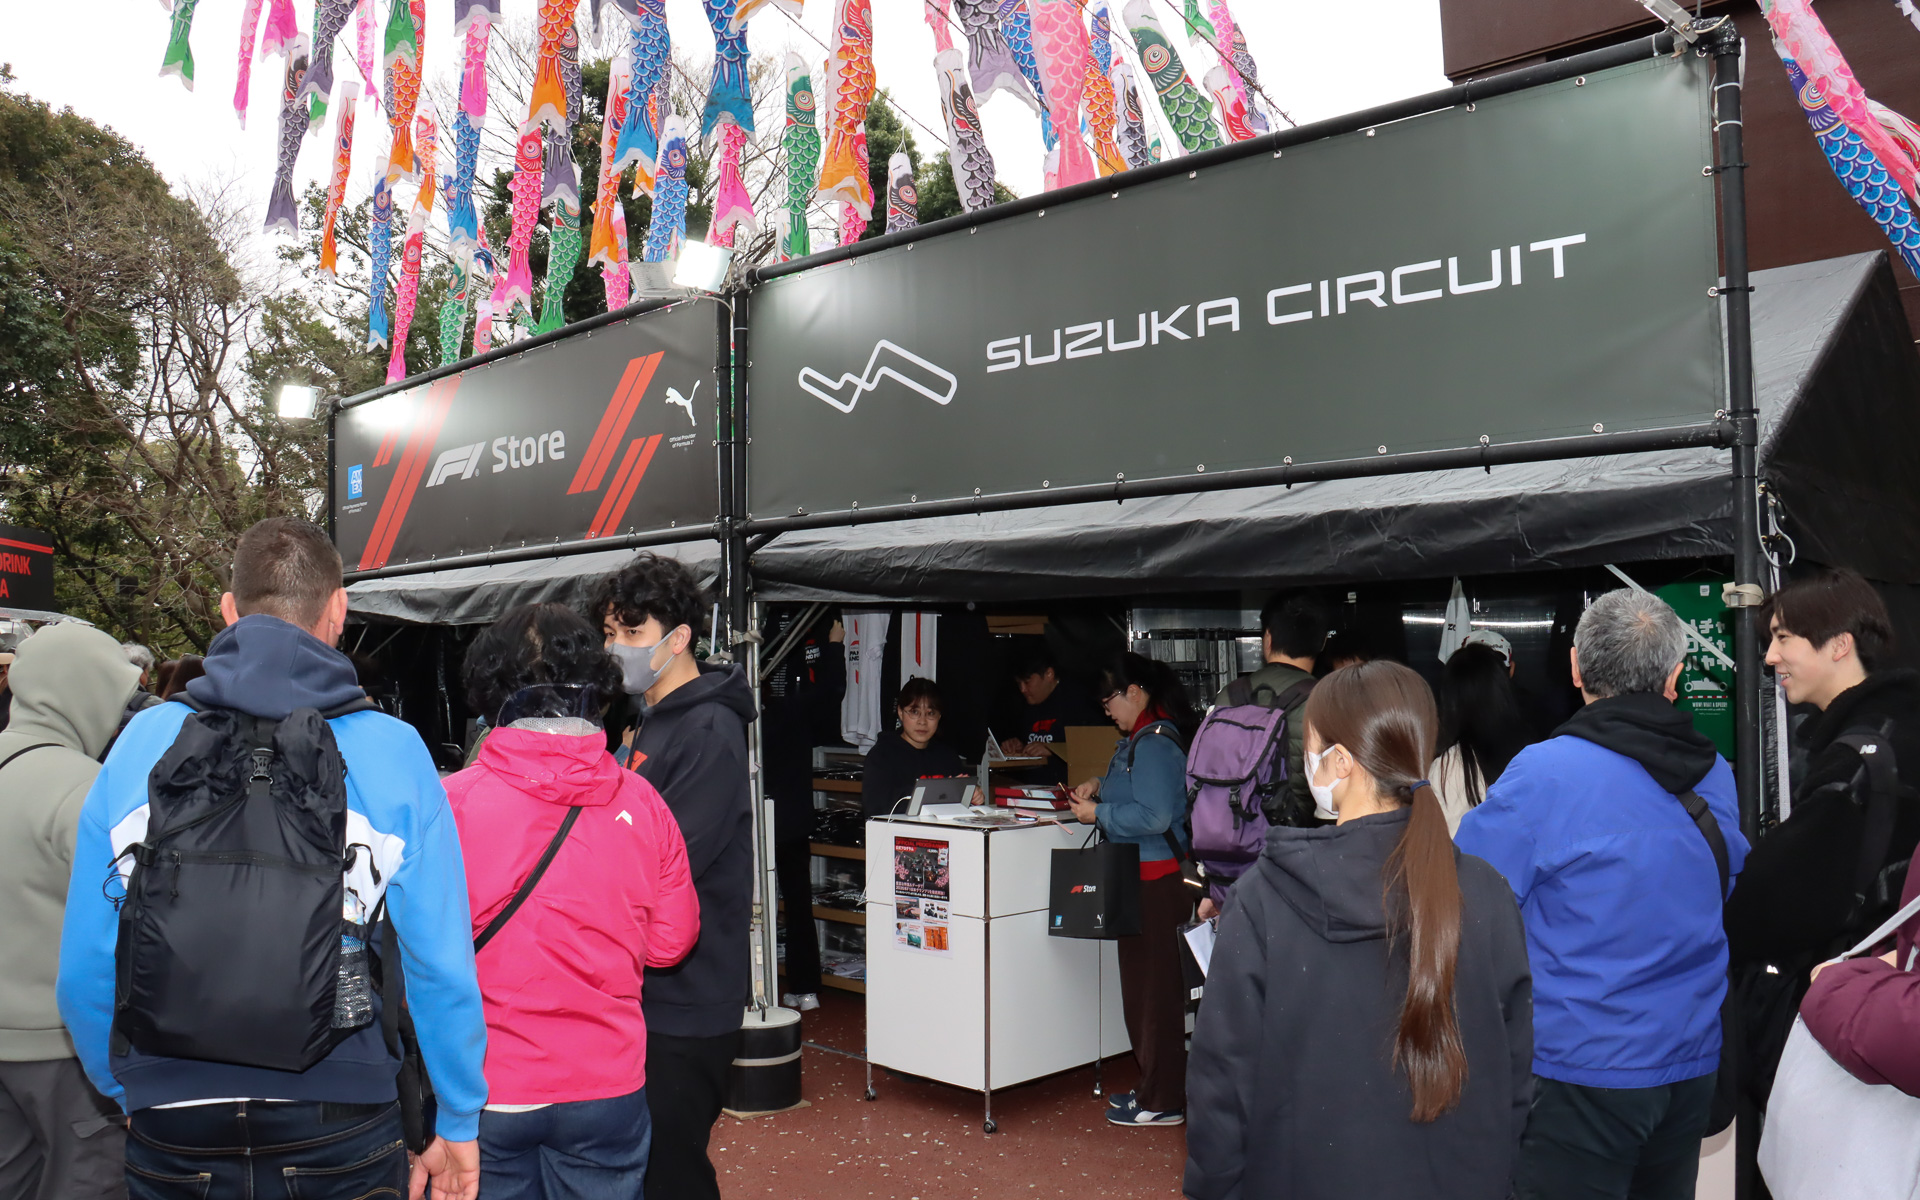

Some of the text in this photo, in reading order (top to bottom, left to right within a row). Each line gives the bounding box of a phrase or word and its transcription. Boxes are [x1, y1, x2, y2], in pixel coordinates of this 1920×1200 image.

[987, 233, 1587, 373] SUZUKA CIRCUIT
[425, 430, 565, 488] F1 Store
[1083, 884, 1097, 893] Store
